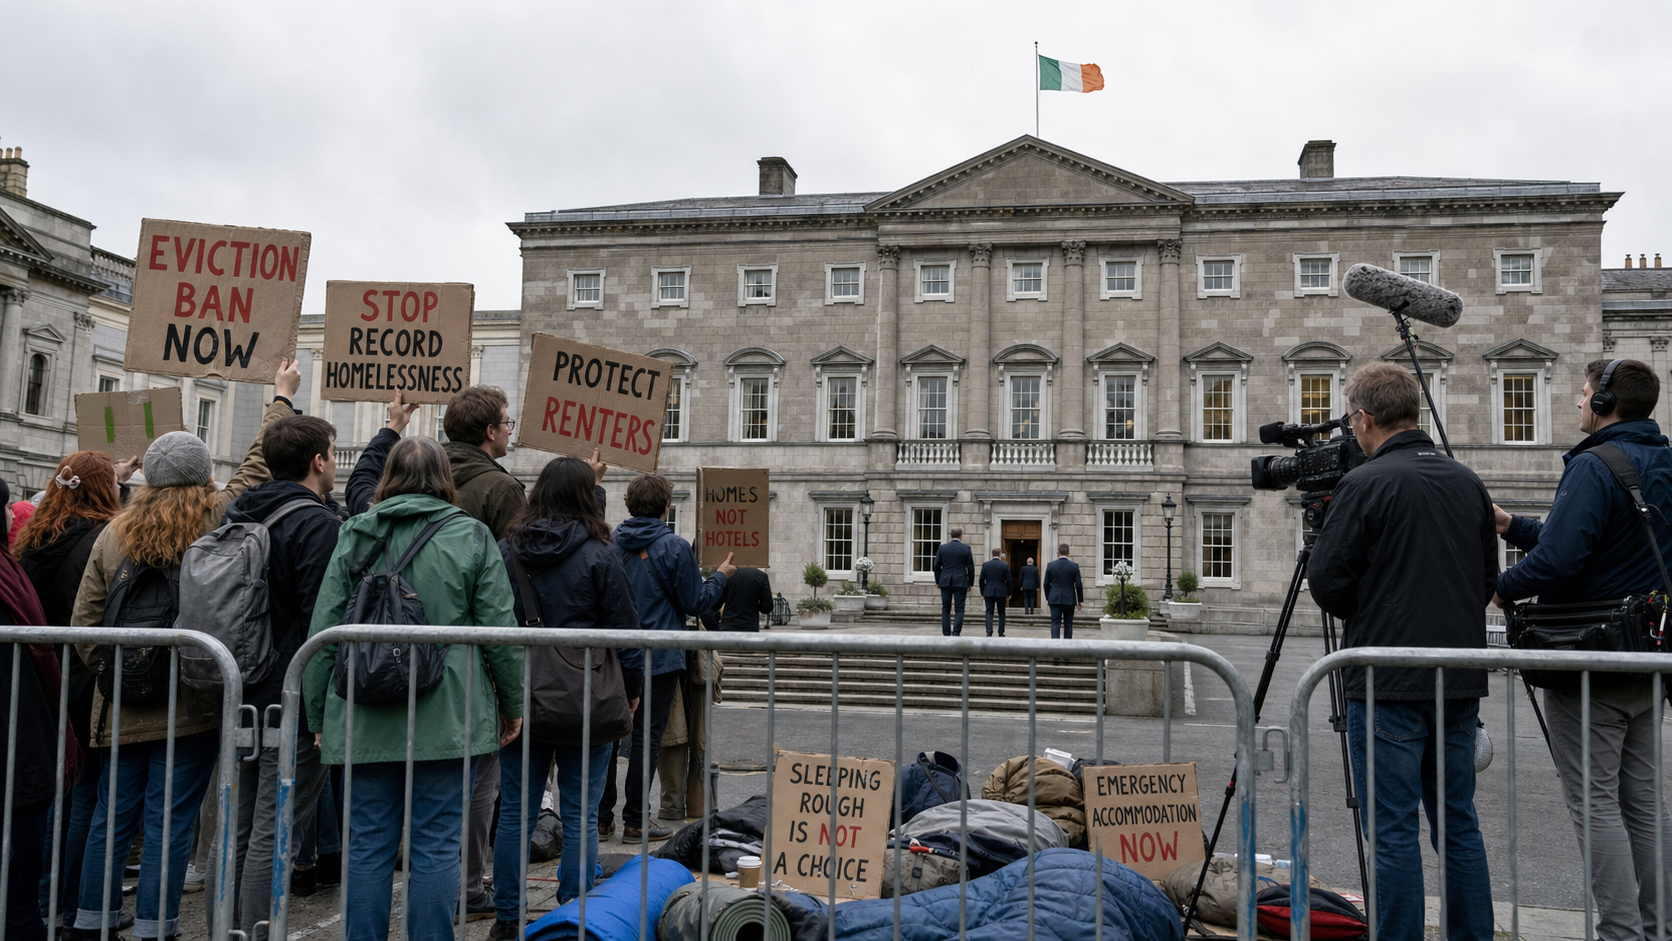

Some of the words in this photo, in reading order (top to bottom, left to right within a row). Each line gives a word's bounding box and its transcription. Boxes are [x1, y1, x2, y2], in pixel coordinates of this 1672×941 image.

[149, 235, 299, 283] EVICTION
[174, 282, 254, 323] BAN
[360, 290, 438, 323] STOP
[163, 323, 259, 369] NOW
[350, 327, 443, 357] RECORD
[326, 362, 463, 393] HOMELESSNESS
[553, 351, 660, 400] PROTECT
[542, 396, 655, 455] RENTERS
[706, 486, 758, 503] HOMES
[716, 509, 747, 525] NOT
[706, 531, 759, 547] HOTELS
[1097, 774, 1186, 796] EMERGENCY
[1093, 804, 1197, 827] ACCOMMODATION
[789, 820, 808, 843] IS
[819, 823, 862, 848] NOT
[1120, 831, 1178, 864] NOW
[773, 852, 787, 875] A
